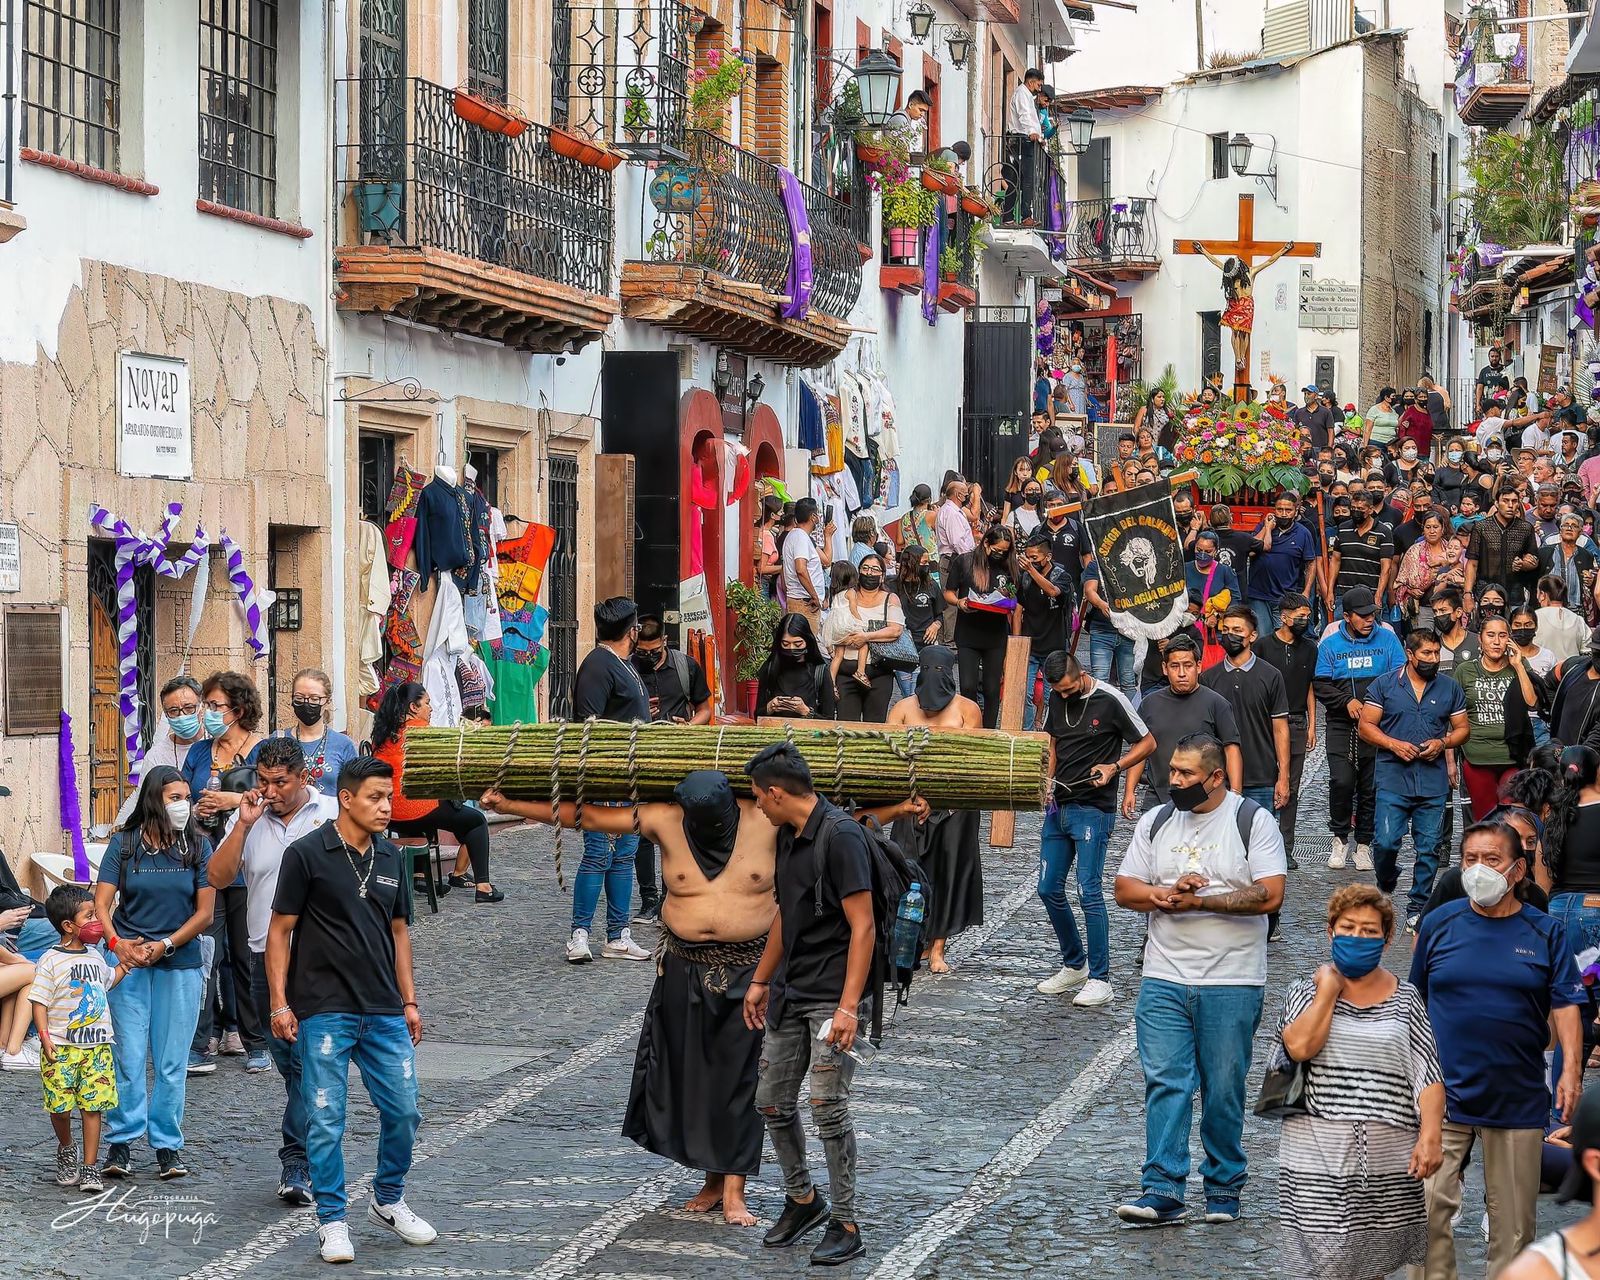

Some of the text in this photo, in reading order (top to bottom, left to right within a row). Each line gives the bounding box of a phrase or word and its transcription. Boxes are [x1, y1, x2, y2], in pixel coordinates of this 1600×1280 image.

[124, 422, 150, 437] APARATOS
[1098, 527, 1121, 557] SEÑOR
[1119, 515, 1137, 530] DEL
[1133, 590, 1158, 605] AGUA
[1336, 648, 1384, 660] BROOKLYN
[1349, 658, 1371, 668] 1992
[66, 1027, 107, 1044] KING
